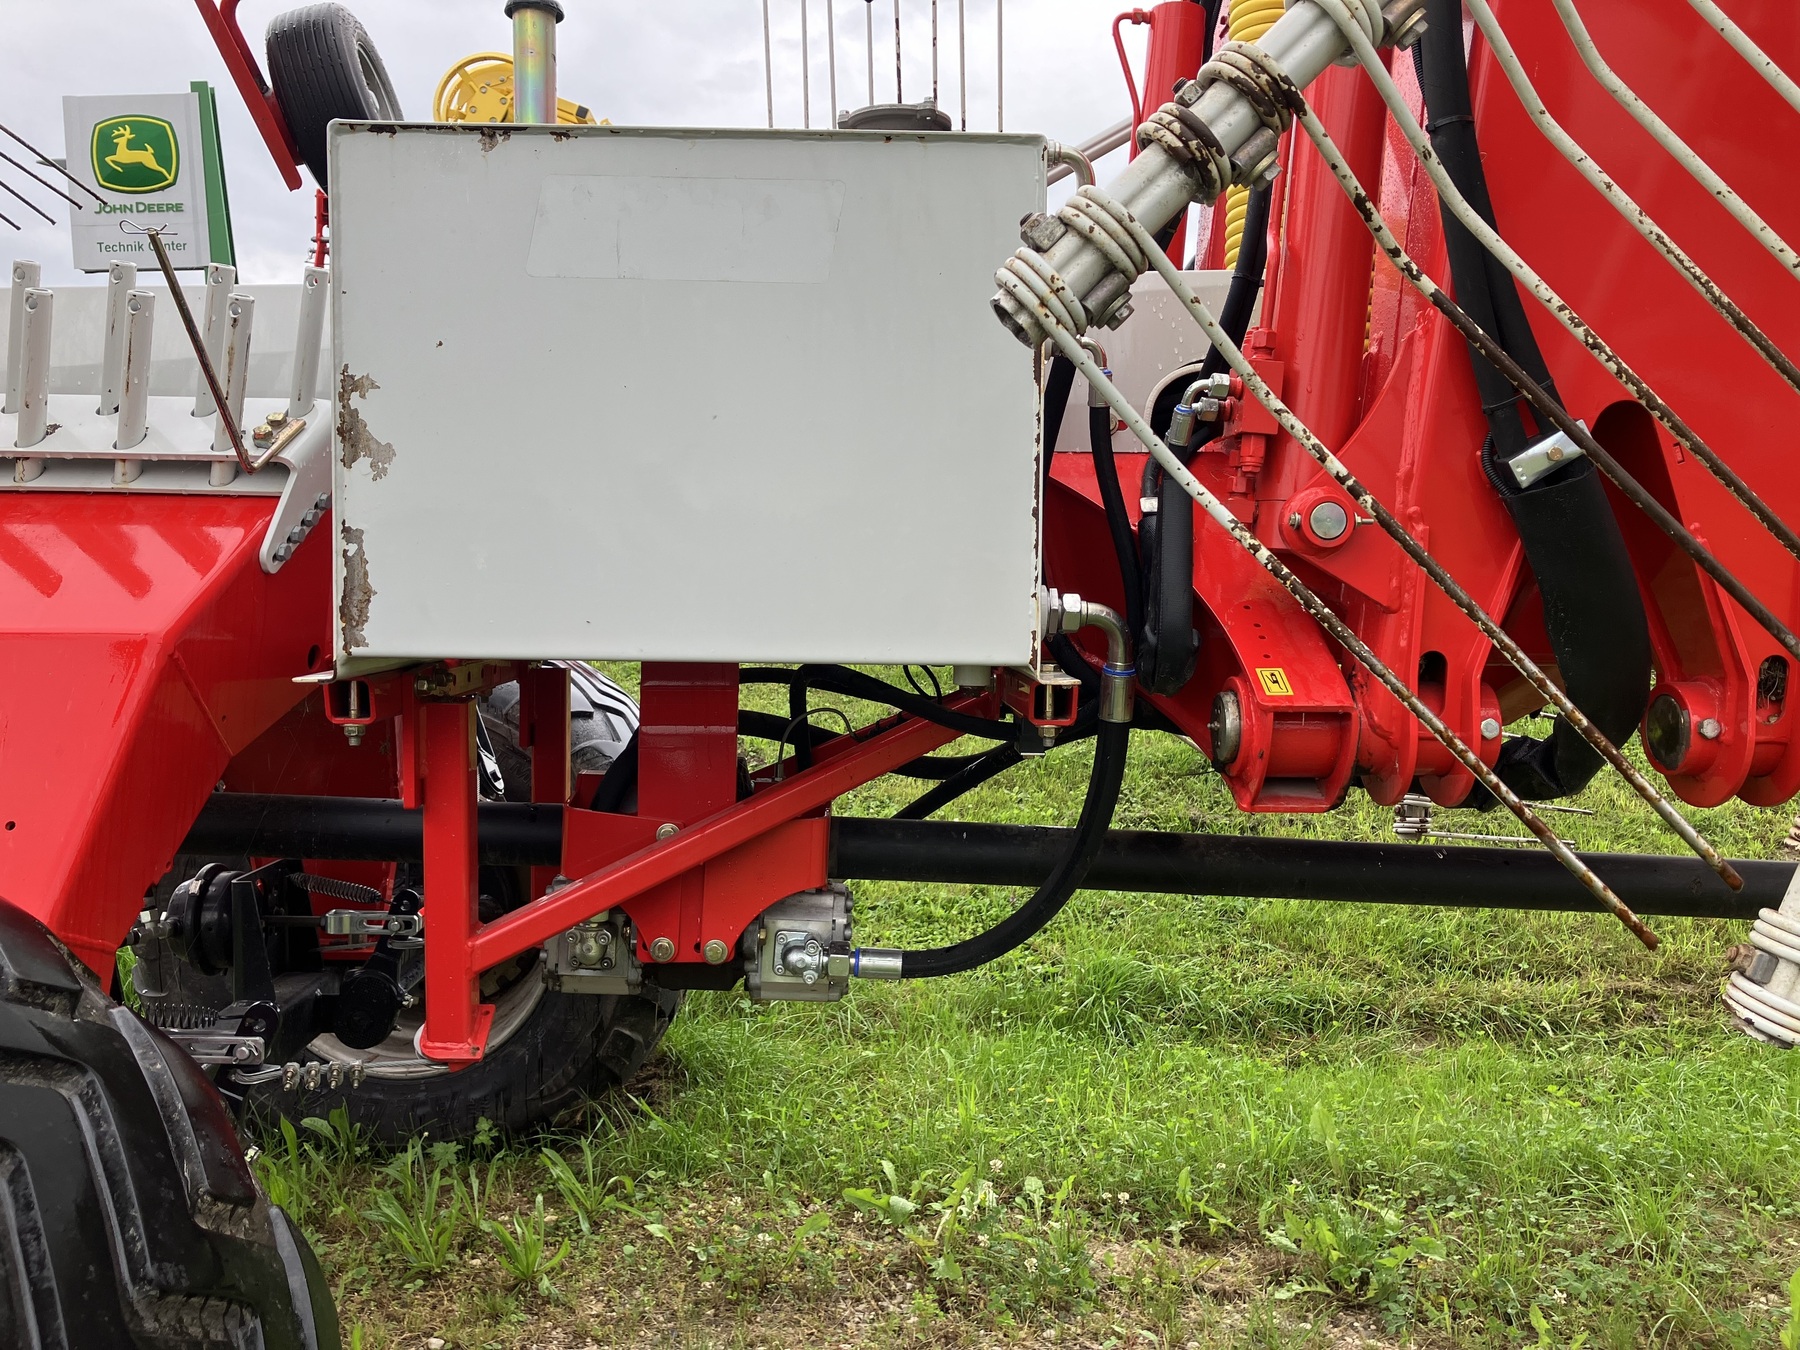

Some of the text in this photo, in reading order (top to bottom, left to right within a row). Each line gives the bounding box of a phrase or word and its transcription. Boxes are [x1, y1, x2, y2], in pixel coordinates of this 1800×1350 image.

[94, 202, 184, 214] JOHN DEERE
[97, 241, 187, 252] Technik Cnter
